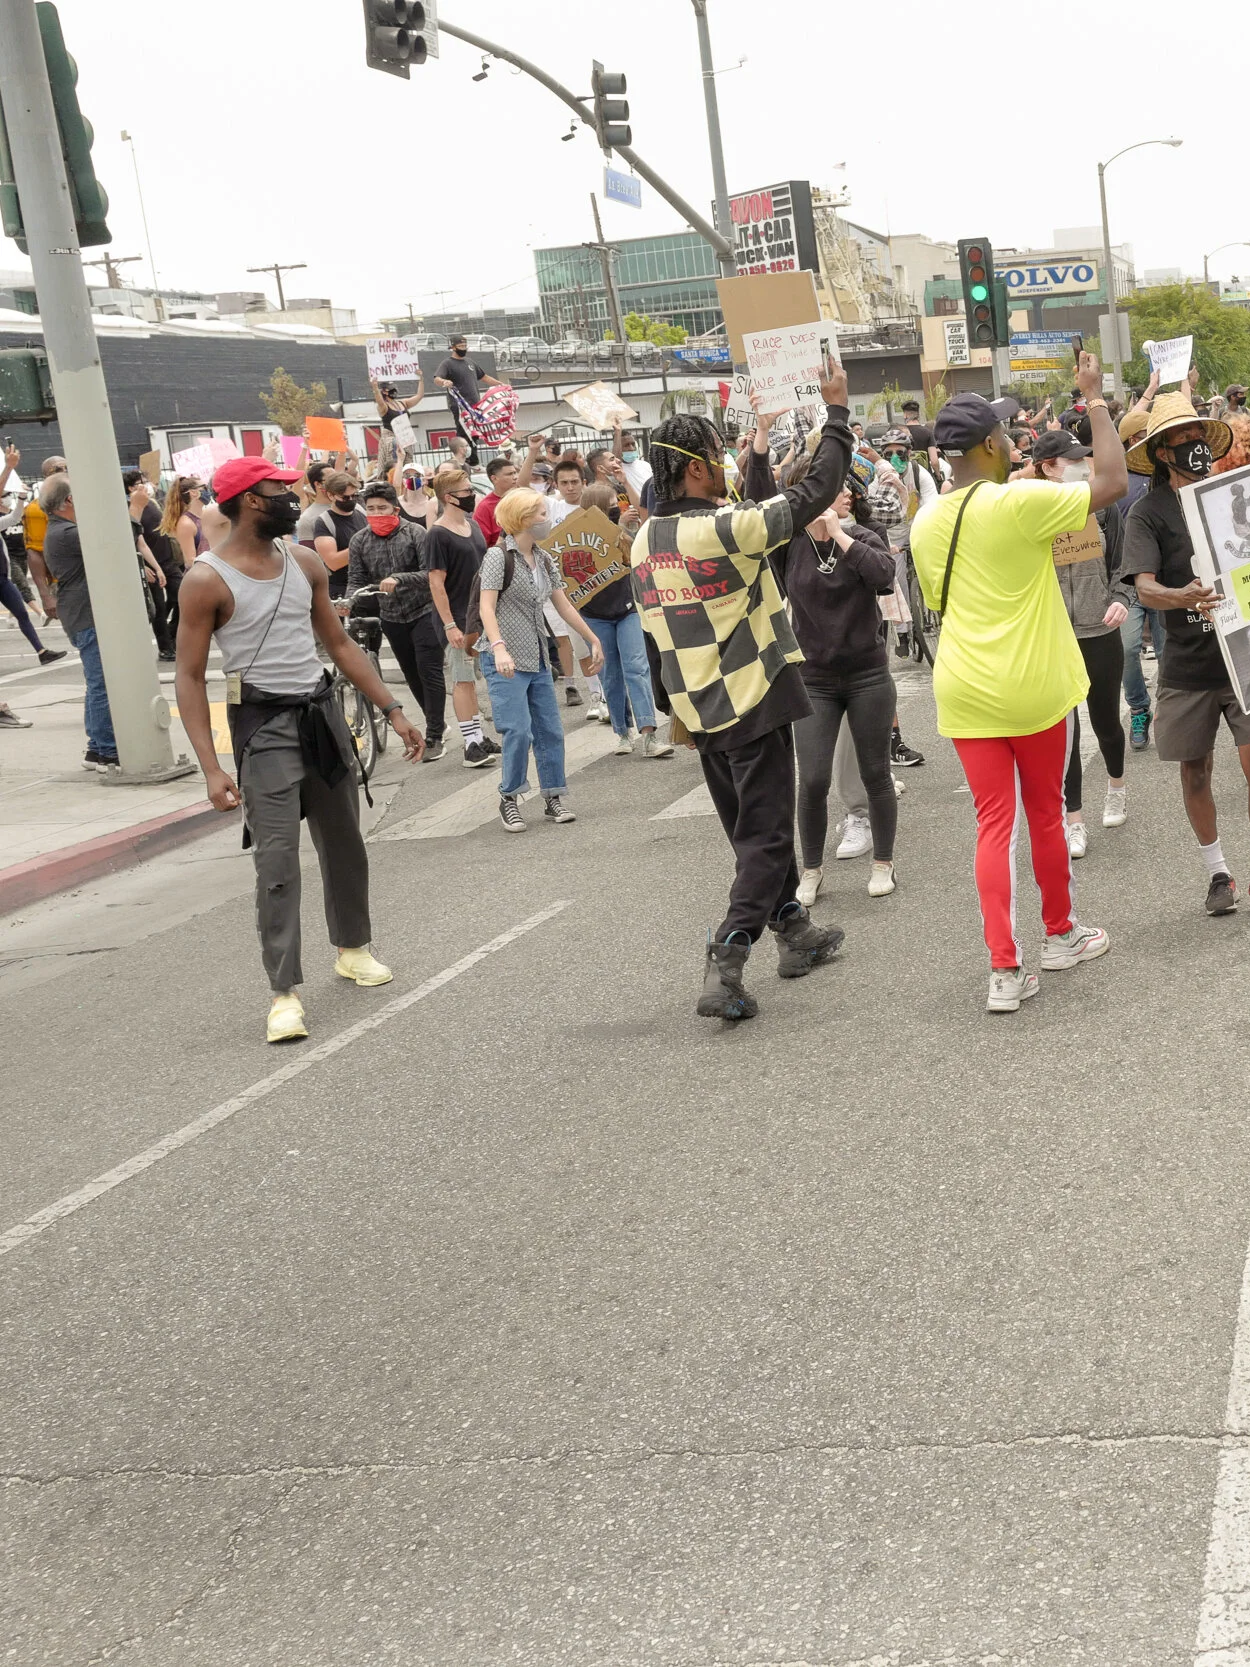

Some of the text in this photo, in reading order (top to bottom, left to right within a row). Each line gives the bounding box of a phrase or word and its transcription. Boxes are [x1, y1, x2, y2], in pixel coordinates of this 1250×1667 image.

[1017, 286, 1053, 294] INDEPENDENT
[378, 339, 409, 353] HANDS
[384, 353, 397, 365] UP
[680, 350, 699, 359] SANTA
[749, 350, 778, 369] NOT
[394, 362, 418, 376] SHOOT
[566, 532, 610, 557] LIVES
[680, 580, 729, 601] BODY
